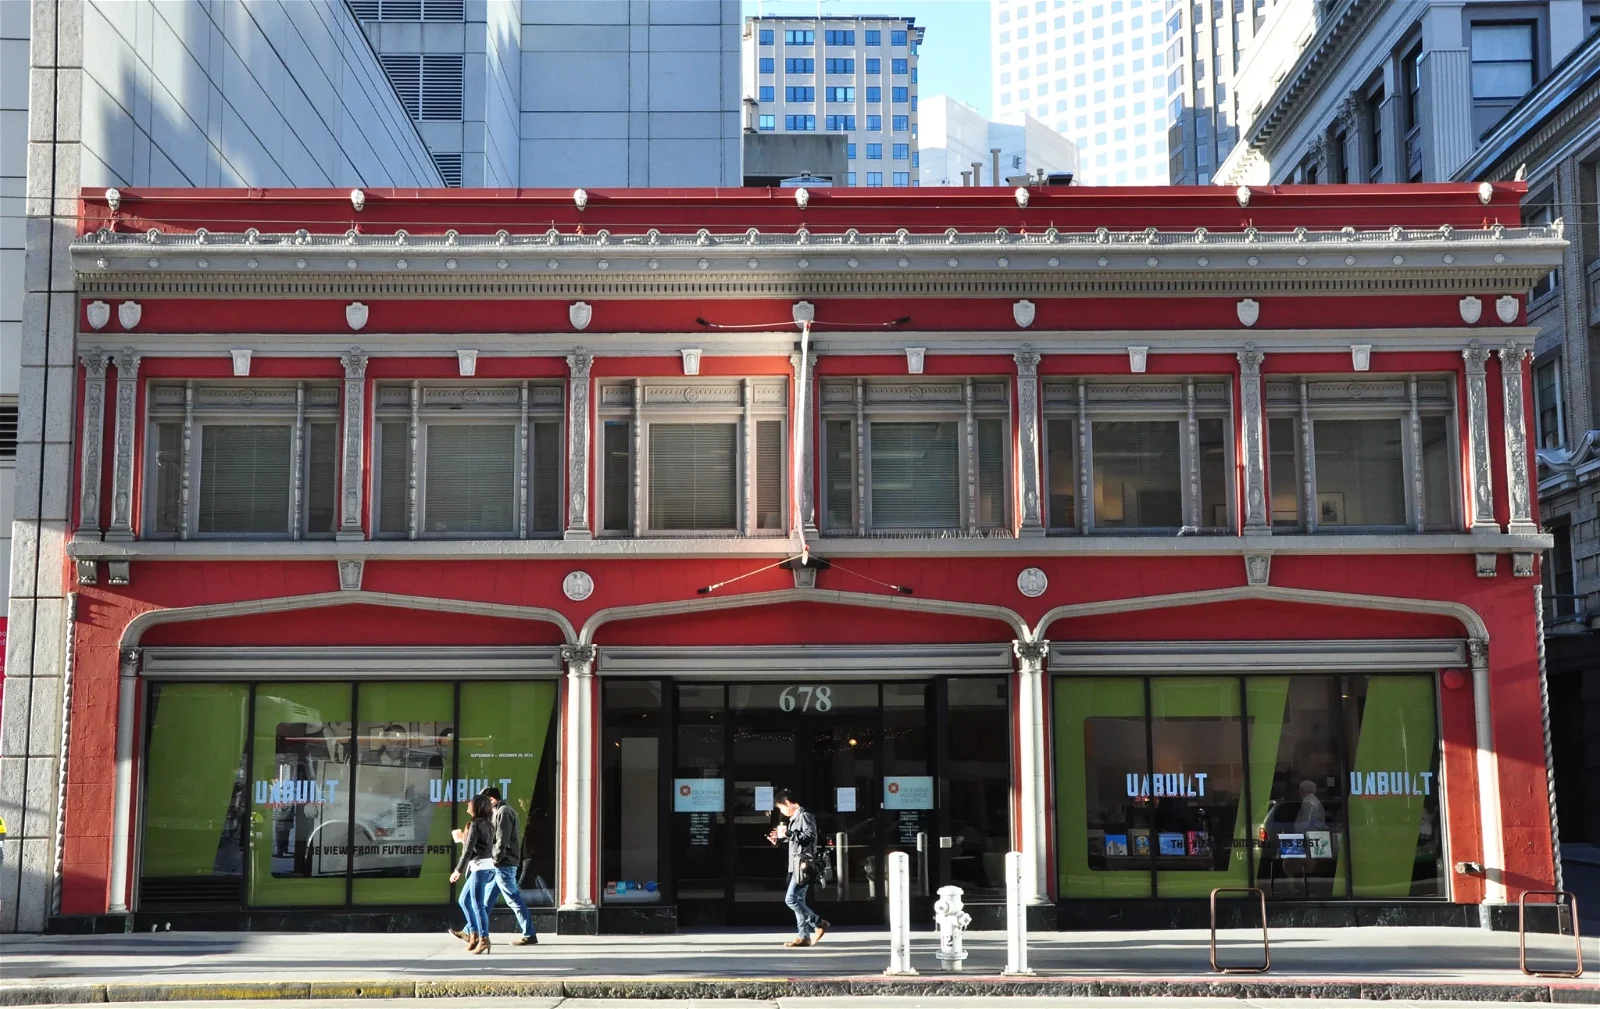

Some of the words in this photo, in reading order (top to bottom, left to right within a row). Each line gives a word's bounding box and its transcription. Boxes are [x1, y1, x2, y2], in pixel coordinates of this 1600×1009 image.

[779, 685, 832, 712] 678
[255, 780, 338, 803] UNBUILT
[1126, 773, 1207, 797] UNBUILT
[1350, 772, 1432, 796] UNBUILT
[324, 846, 348, 855] VIEW
[354, 845, 379, 855] FROM
[382, 845, 424, 855] FUTURES
[428, 845, 450, 854] PAST
